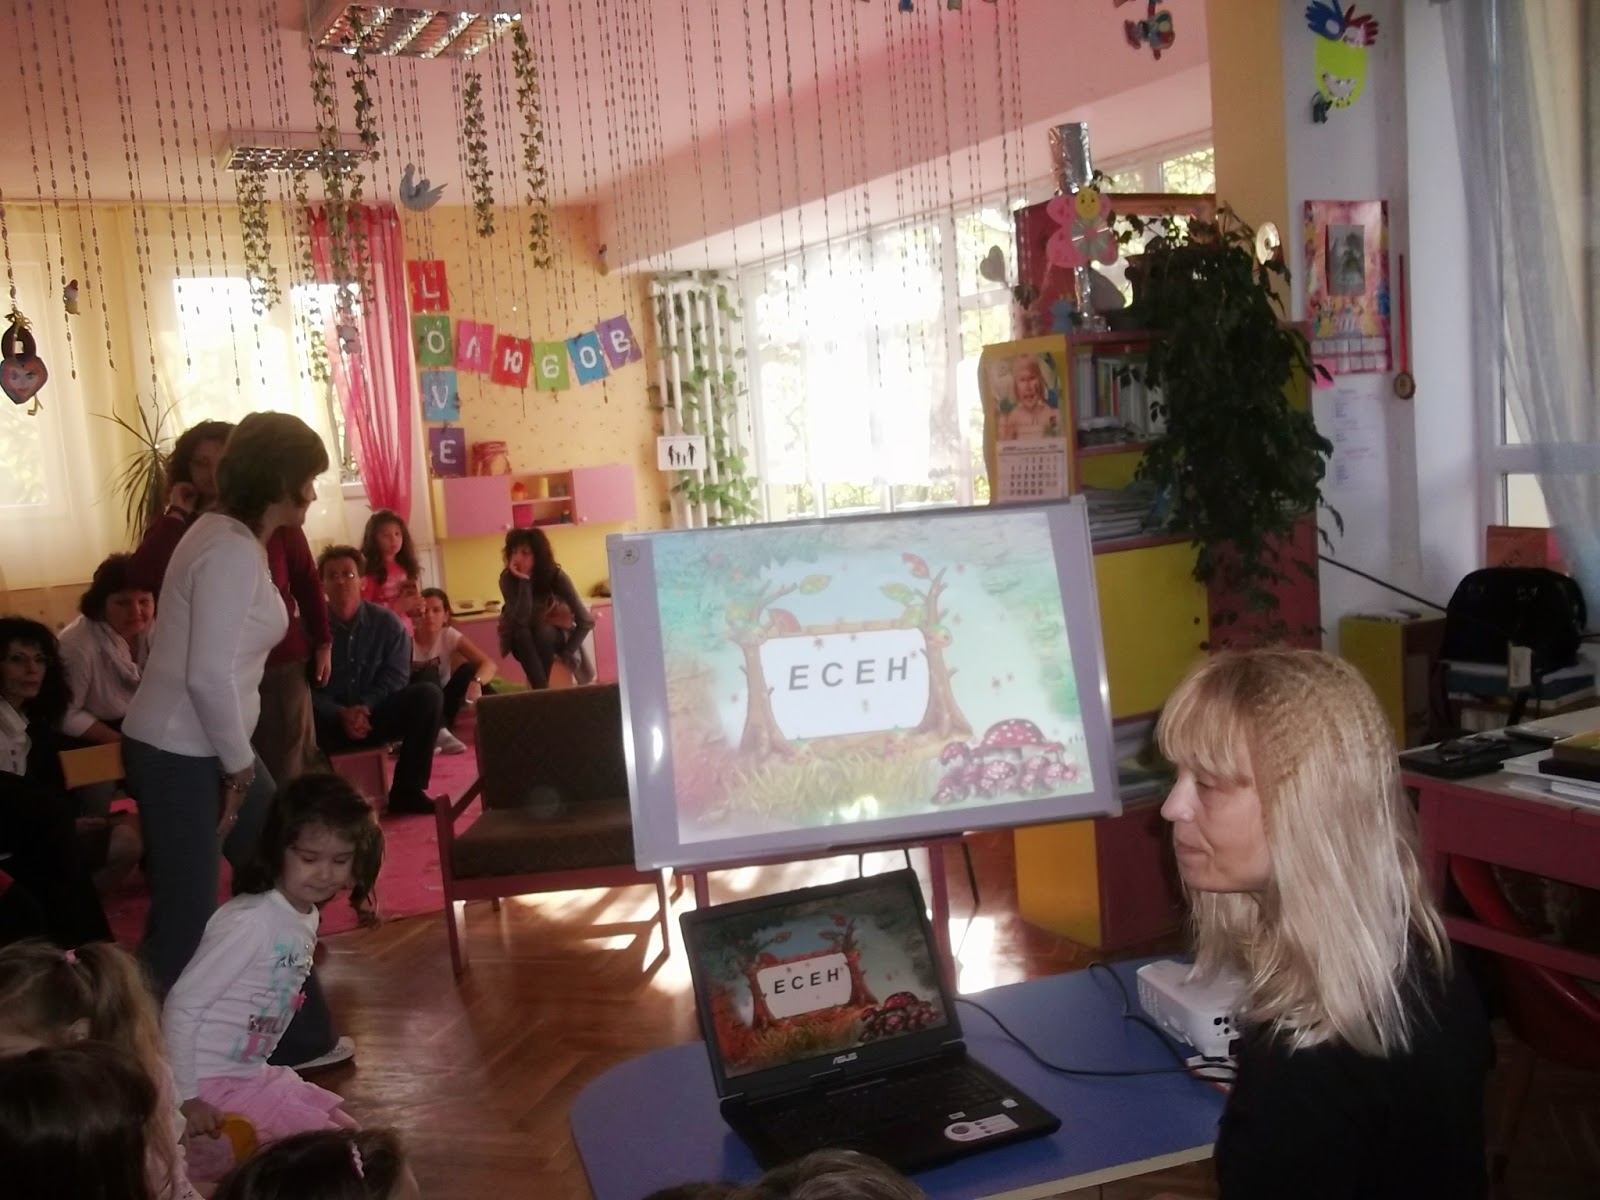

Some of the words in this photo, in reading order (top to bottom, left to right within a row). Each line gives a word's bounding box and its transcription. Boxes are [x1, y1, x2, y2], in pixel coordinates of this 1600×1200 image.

[422, 274, 457, 464] LOVE
[789, 656, 908, 691] ЕСЕН
[773, 968, 840, 994] ЕСЕН
[832, 1052, 858, 1065] ASUS
